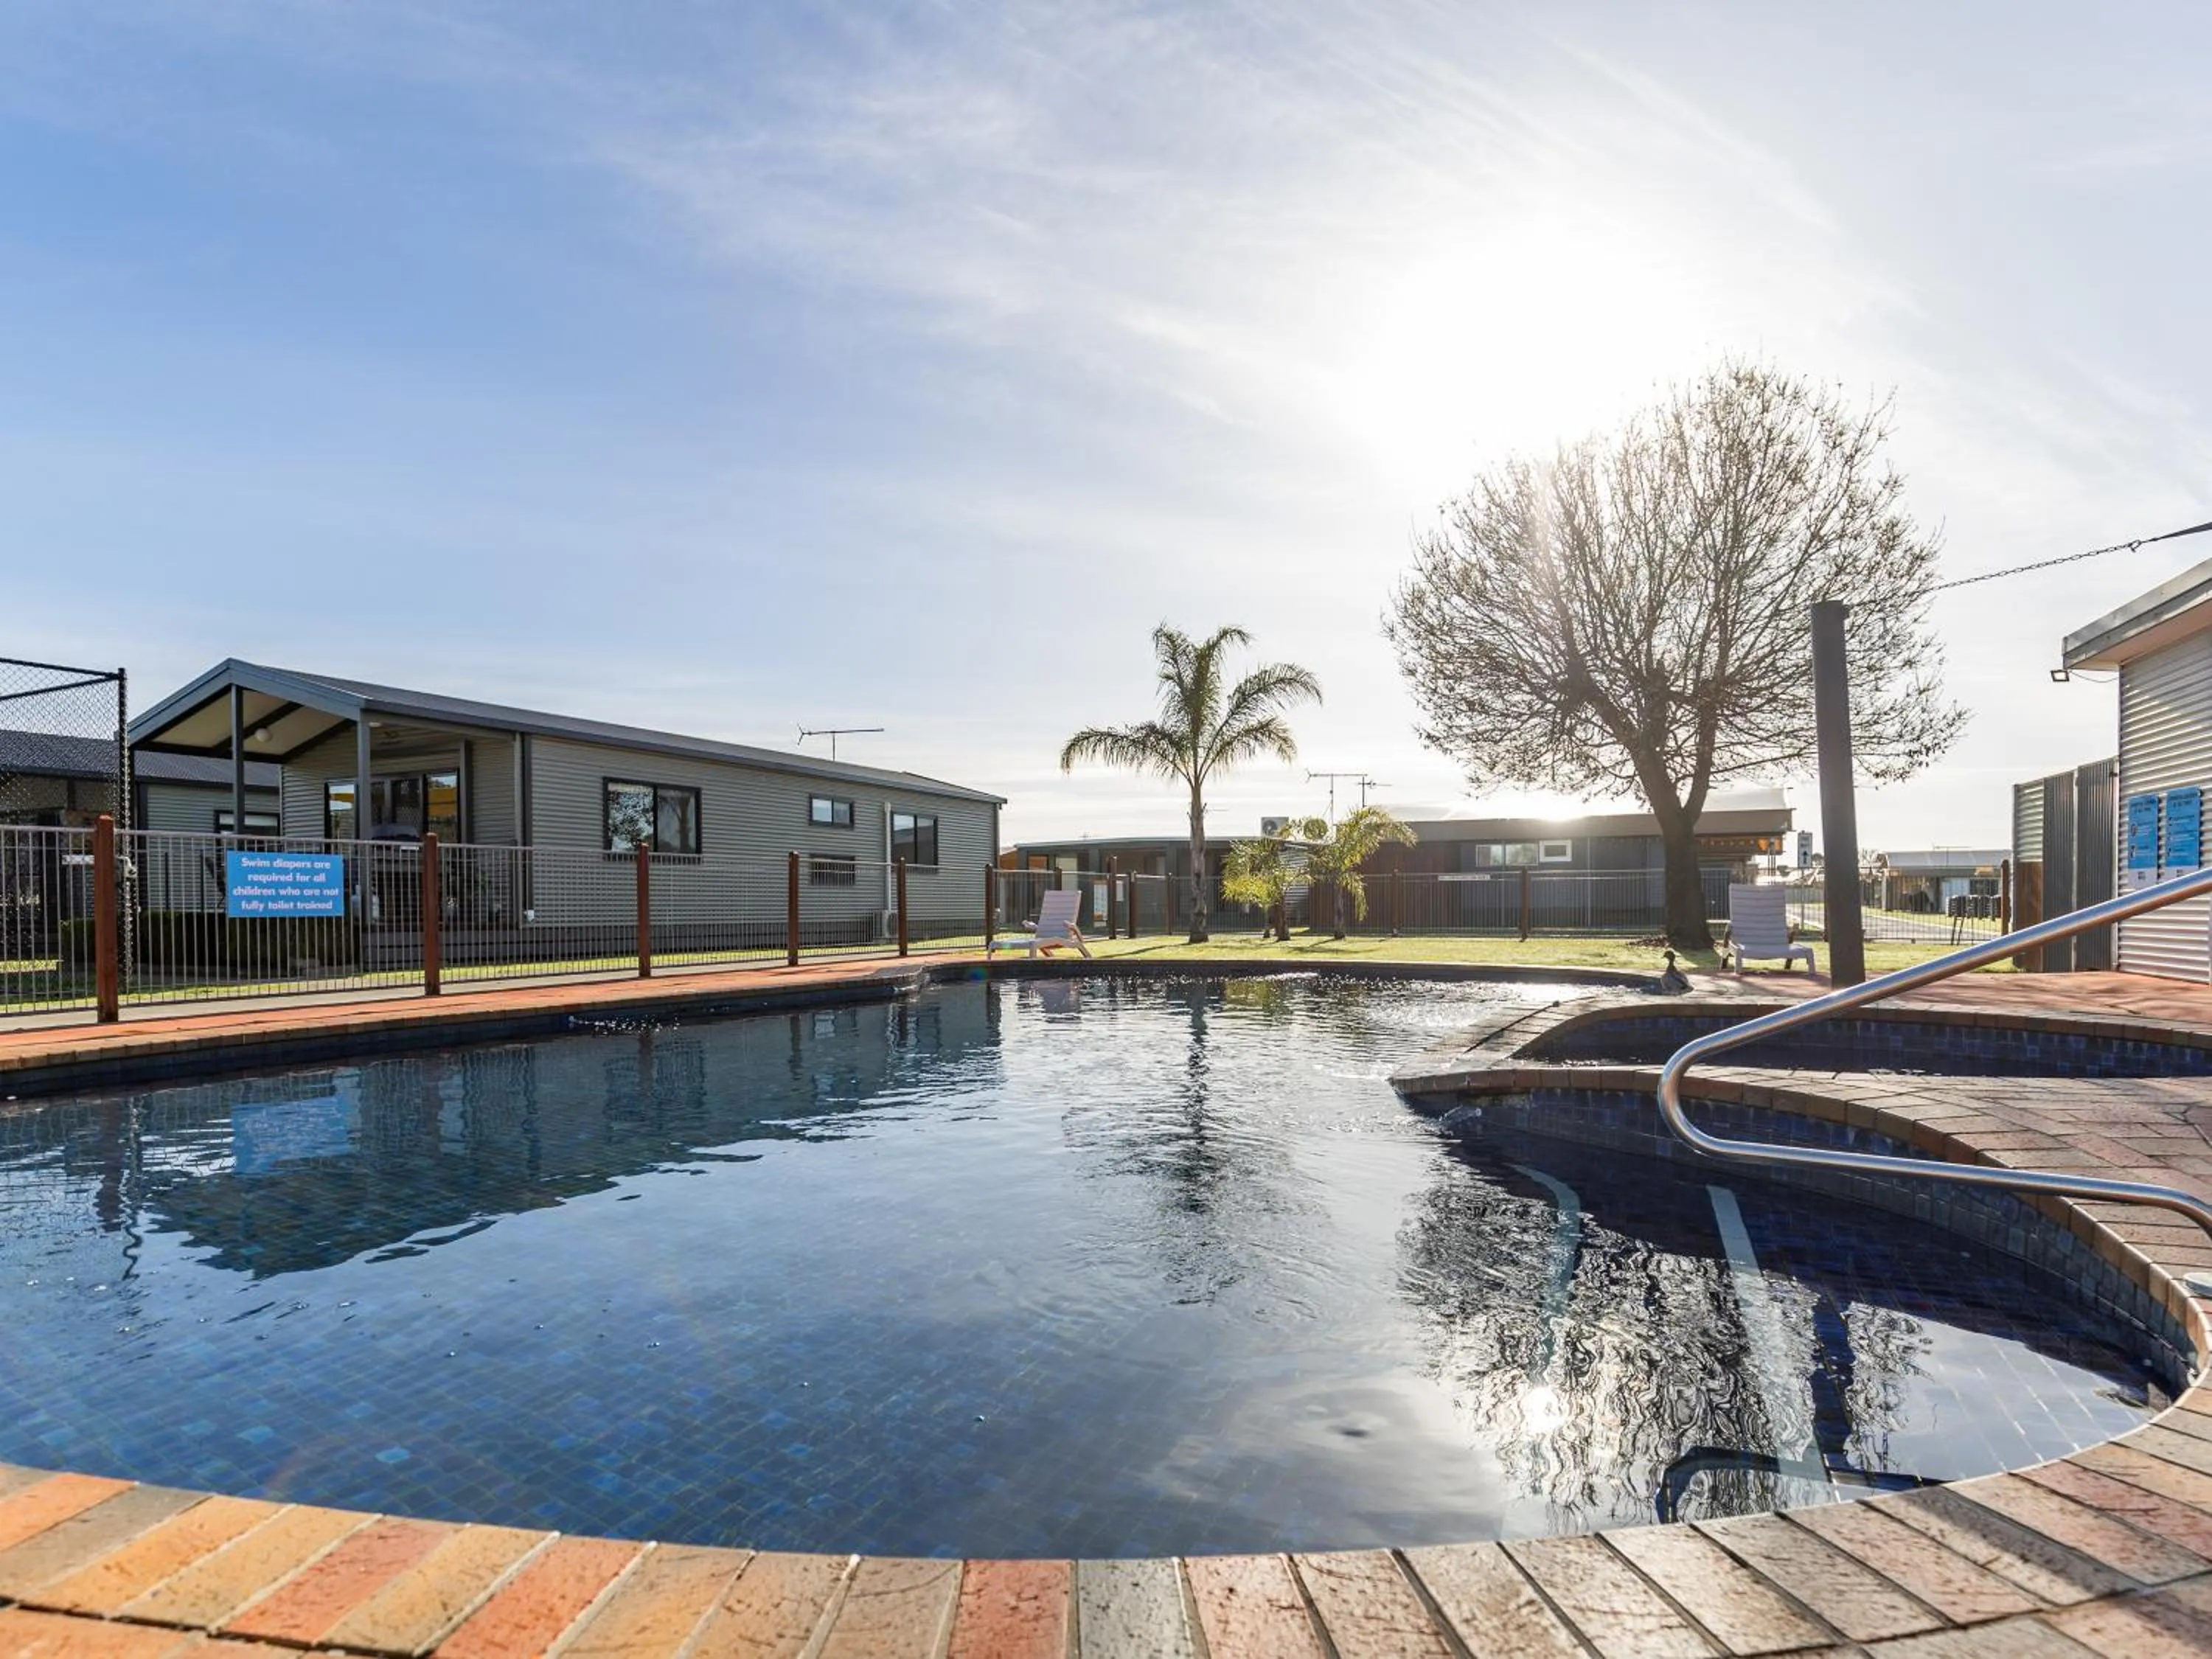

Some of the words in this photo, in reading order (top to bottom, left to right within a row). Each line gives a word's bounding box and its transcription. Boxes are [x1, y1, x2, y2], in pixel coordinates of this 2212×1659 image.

[241, 858, 271, 868] Swim
[273, 858, 311, 870] diapers
[313, 861, 331, 869] are
[248, 873, 293, 884] required
[296, 873, 310, 883] for
[313, 873, 326, 883] all
[233, 886, 276, 896] children
[279, 886, 300, 896] who
[324, 888, 339, 897] not
[241, 900, 264, 912] fully
[268, 900, 293, 909] toilet
[297, 900, 333, 910] trained
